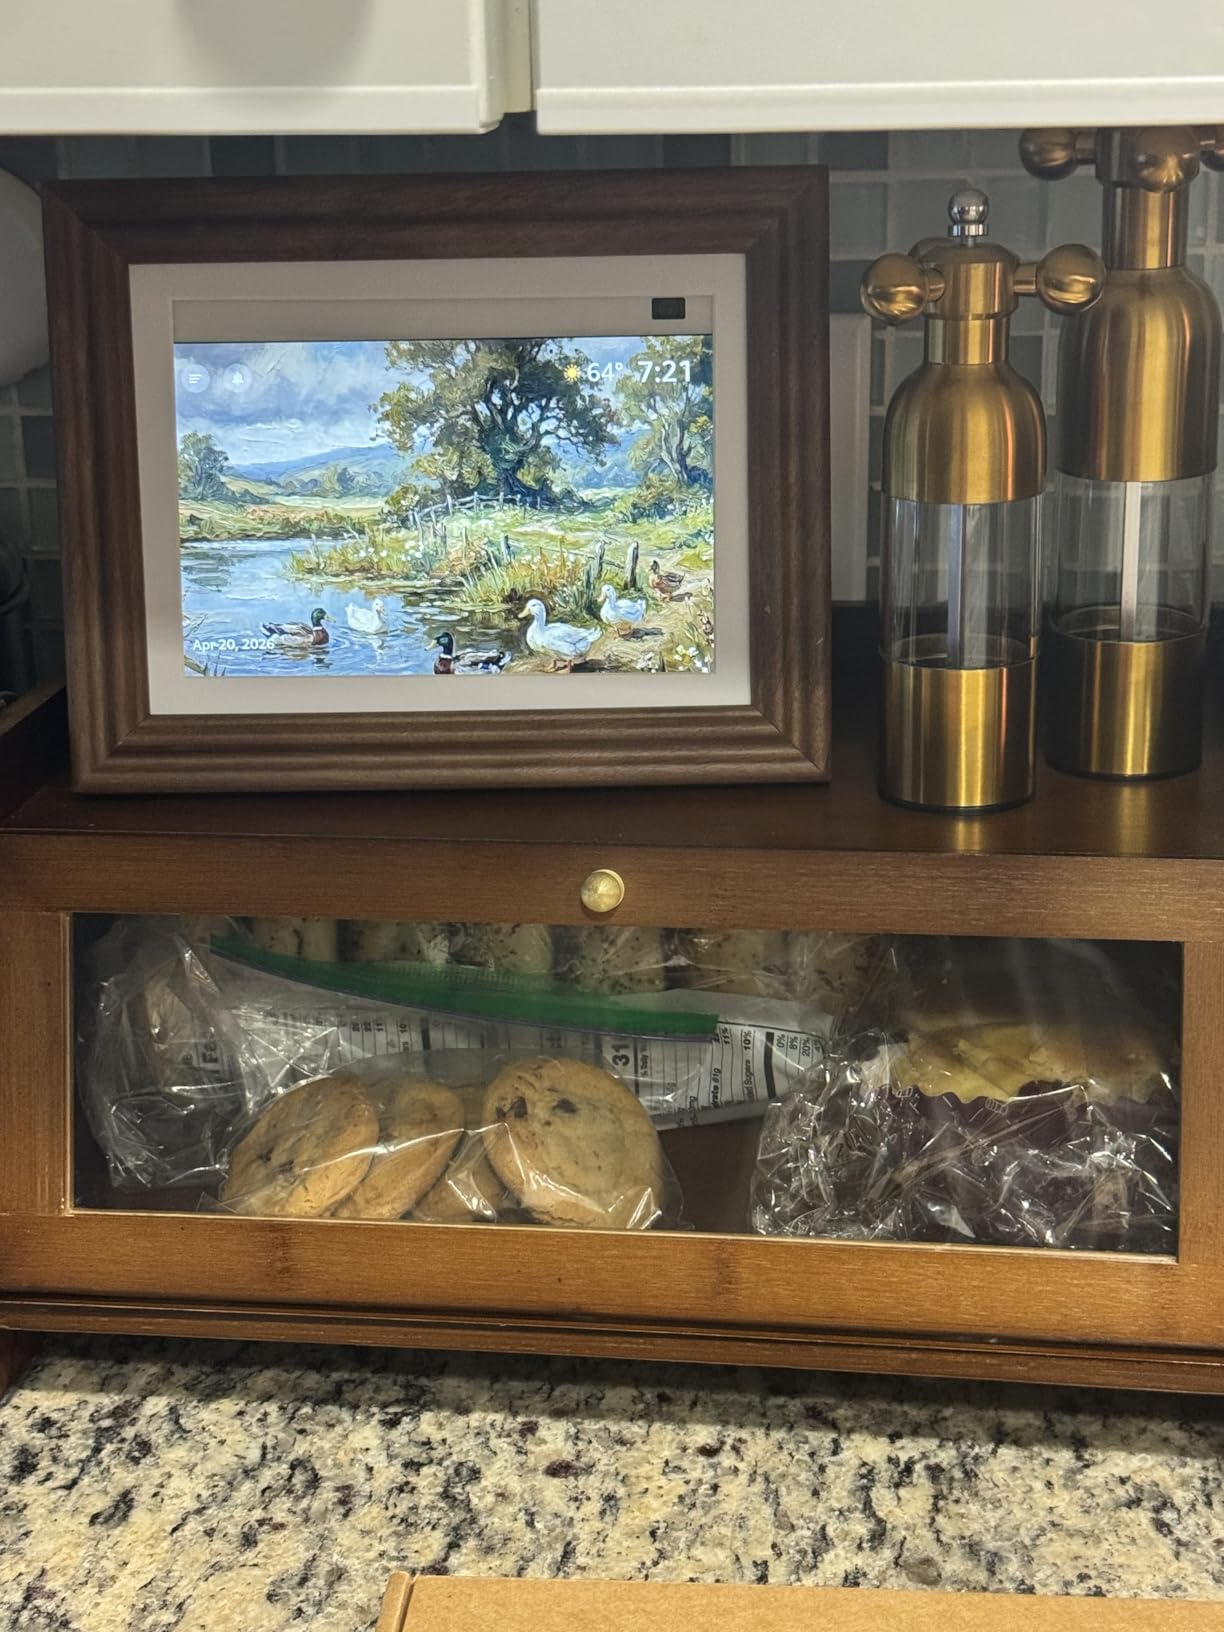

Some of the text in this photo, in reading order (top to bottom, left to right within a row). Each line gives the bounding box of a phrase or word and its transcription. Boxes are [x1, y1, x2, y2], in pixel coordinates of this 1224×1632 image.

[586, 360, 691, 383] 64° 7:21
[192, 639, 275, 653] Apr 20, 2026
[743, 1030, 752, 1051] 10%
[776, 1034, 785, 1048] 0%
[801, 1037, 810, 1057] 20%
